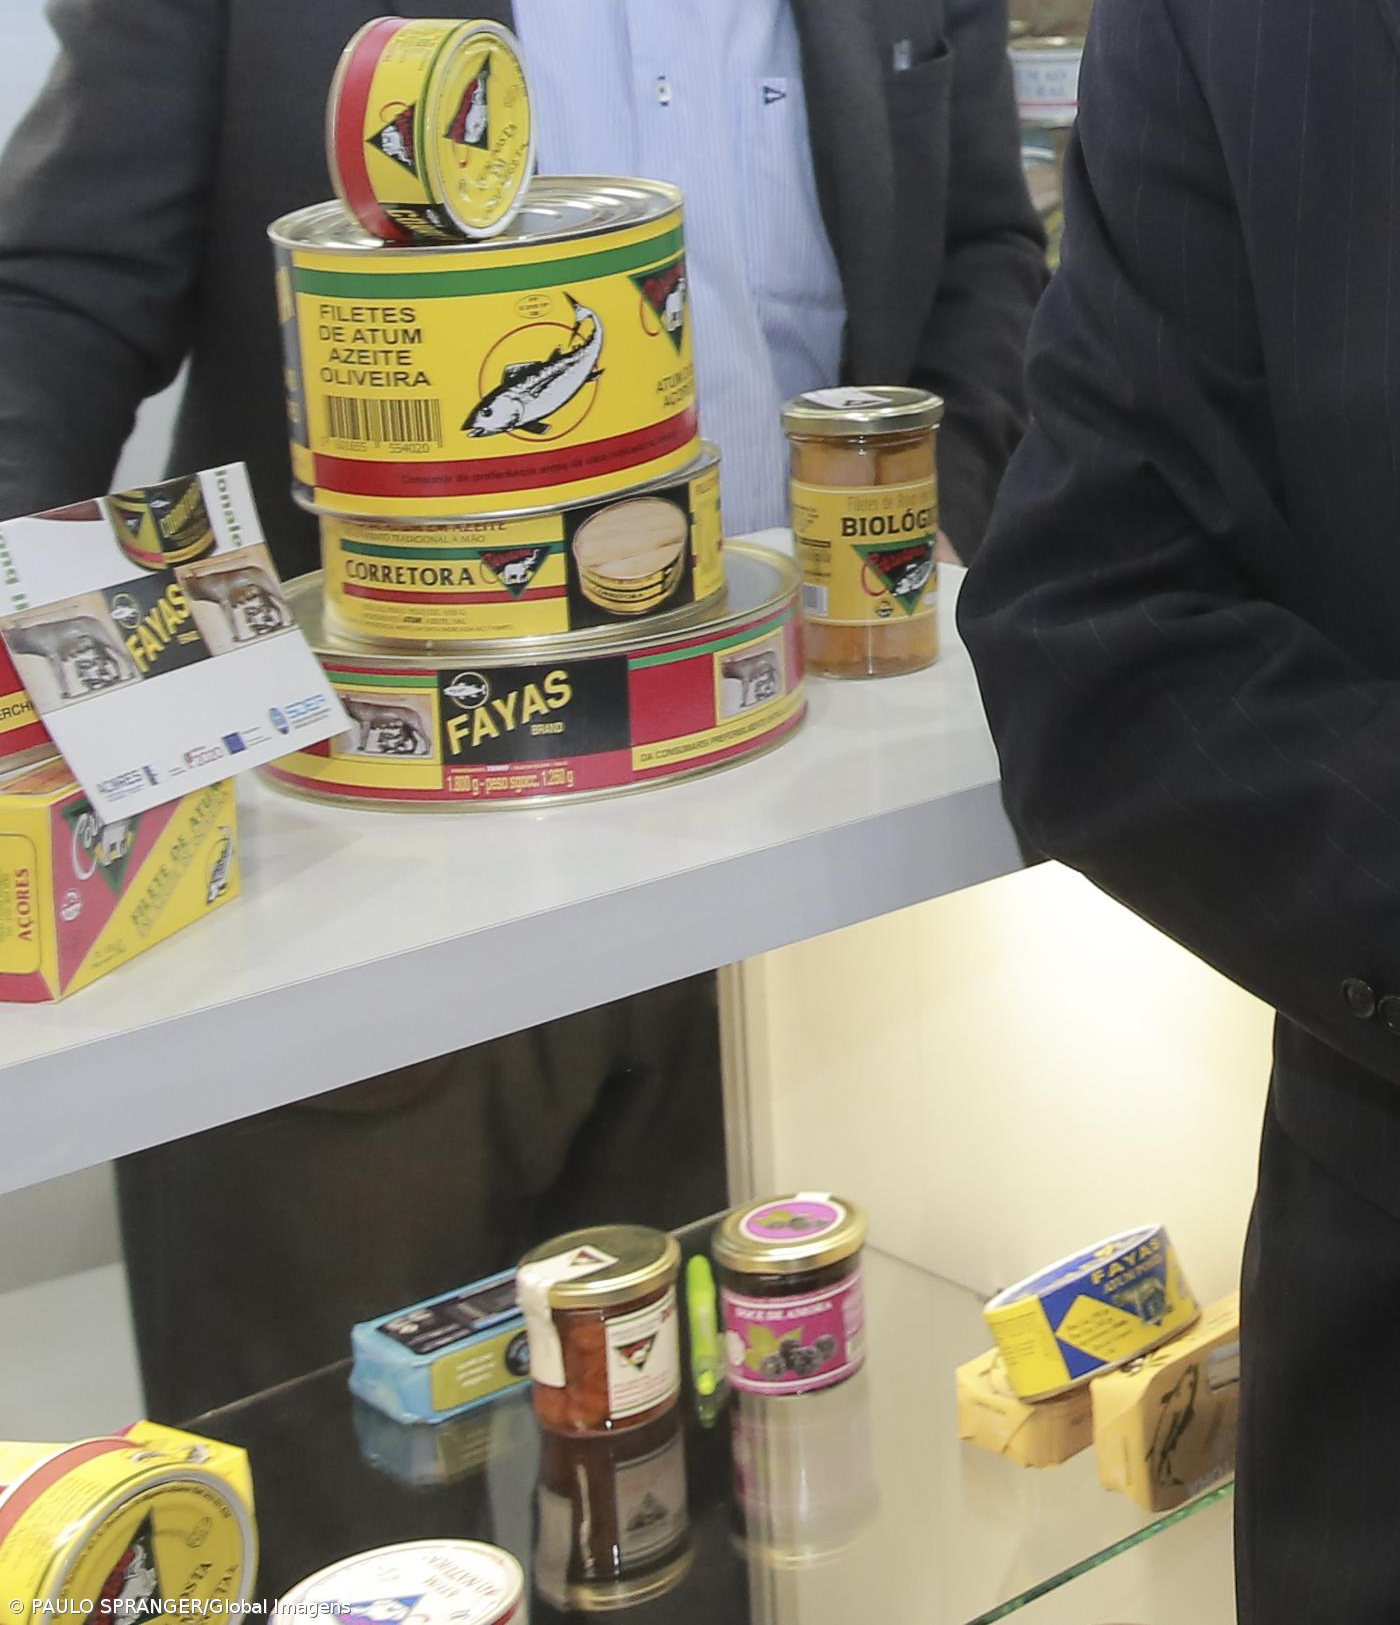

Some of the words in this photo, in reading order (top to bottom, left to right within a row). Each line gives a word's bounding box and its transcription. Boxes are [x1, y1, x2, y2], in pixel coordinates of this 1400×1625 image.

[319, 303, 417, 324] FILETES
[318, 325, 346, 343] DE
[351, 328, 423, 345] ATUM
[328, 348, 413, 366] AZEITE
[319, 366, 432, 388] OLIVEIRA
[841, 505, 935, 537] BIOLÓG
[345, 559, 476, 587] CORRETORA
[126, 583, 192, 674] FAYAS
[446, 669, 573, 756] FAYAS
[14, 867, 33, 942] AÇORES
